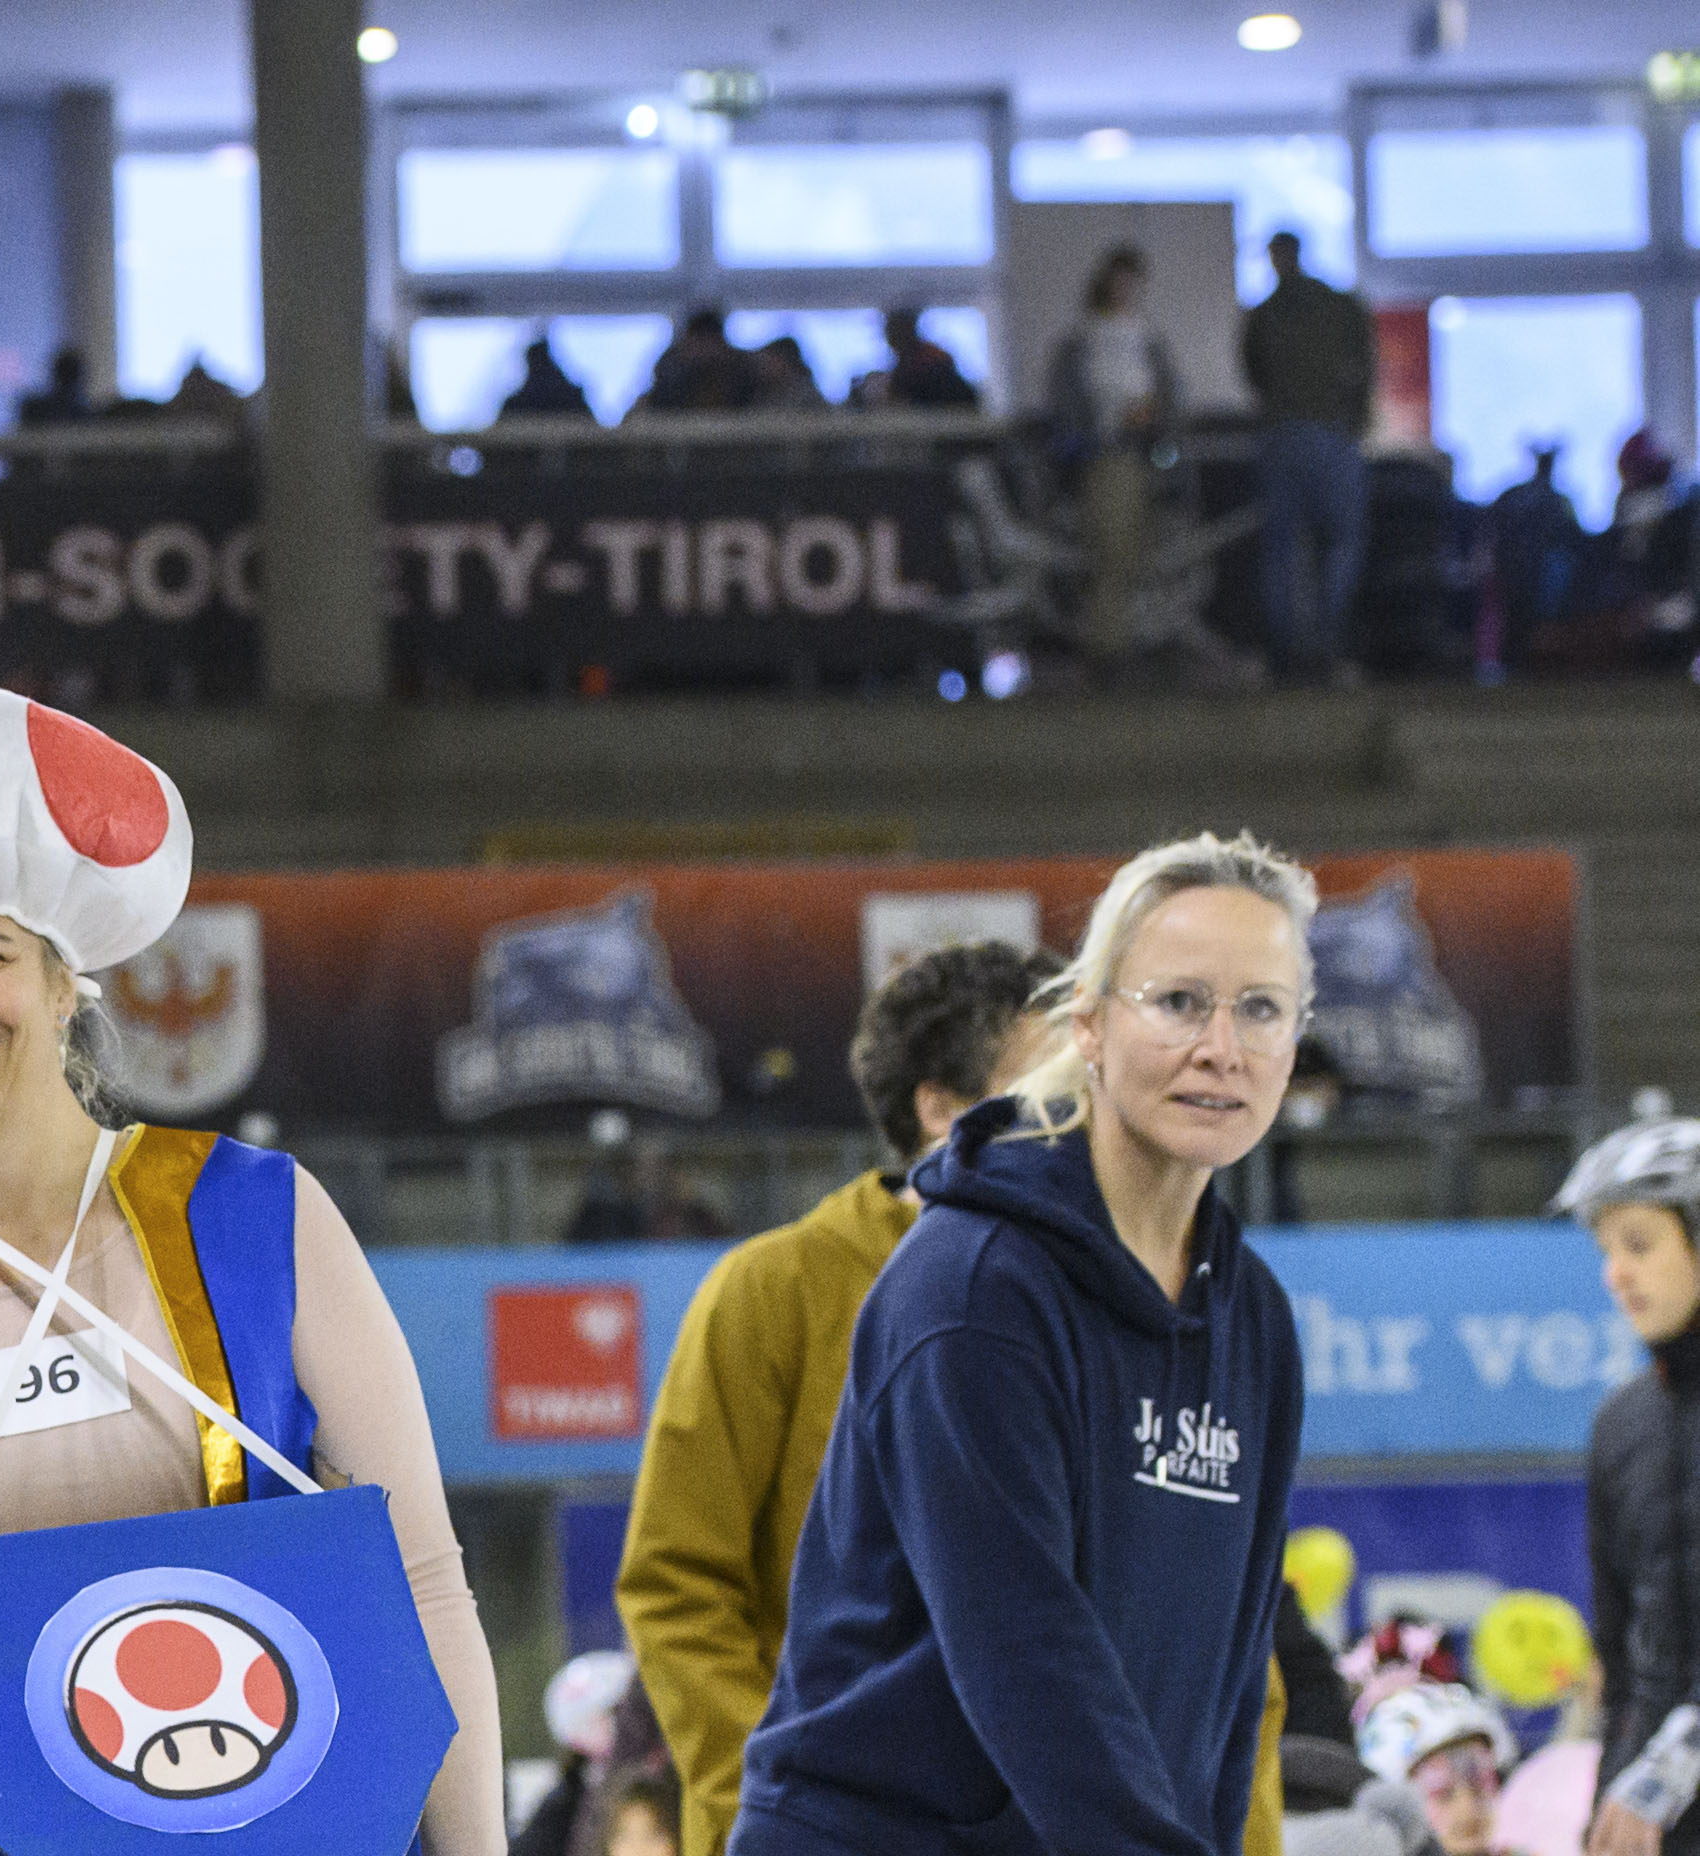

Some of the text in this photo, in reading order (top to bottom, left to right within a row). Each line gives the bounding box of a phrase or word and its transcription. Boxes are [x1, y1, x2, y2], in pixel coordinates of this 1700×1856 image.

[1290, 1292, 1432, 1394] hr
[15, 1354, 80, 1403] 96
[1142, 1443, 1230, 1488] PRFAITE
